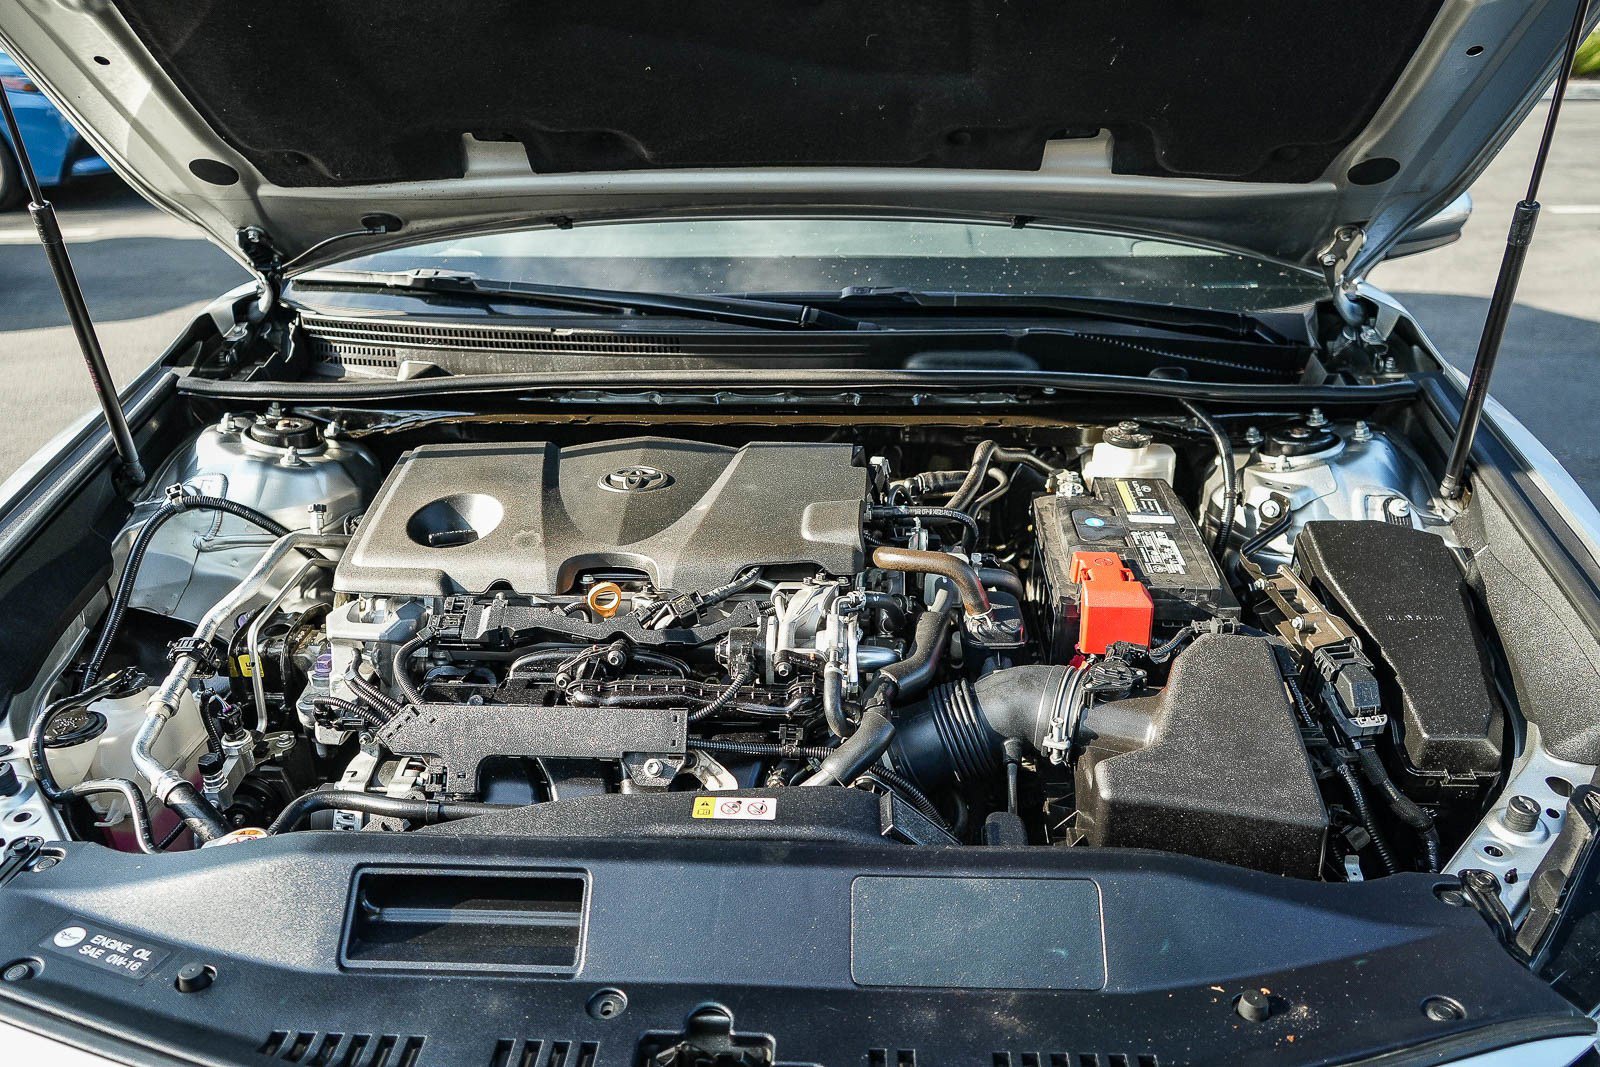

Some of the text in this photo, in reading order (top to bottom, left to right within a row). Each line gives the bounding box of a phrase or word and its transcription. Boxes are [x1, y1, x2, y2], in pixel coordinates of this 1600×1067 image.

[78, 945, 105, 959] SAE
[90, 935, 152, 961] ENGINE OIL
